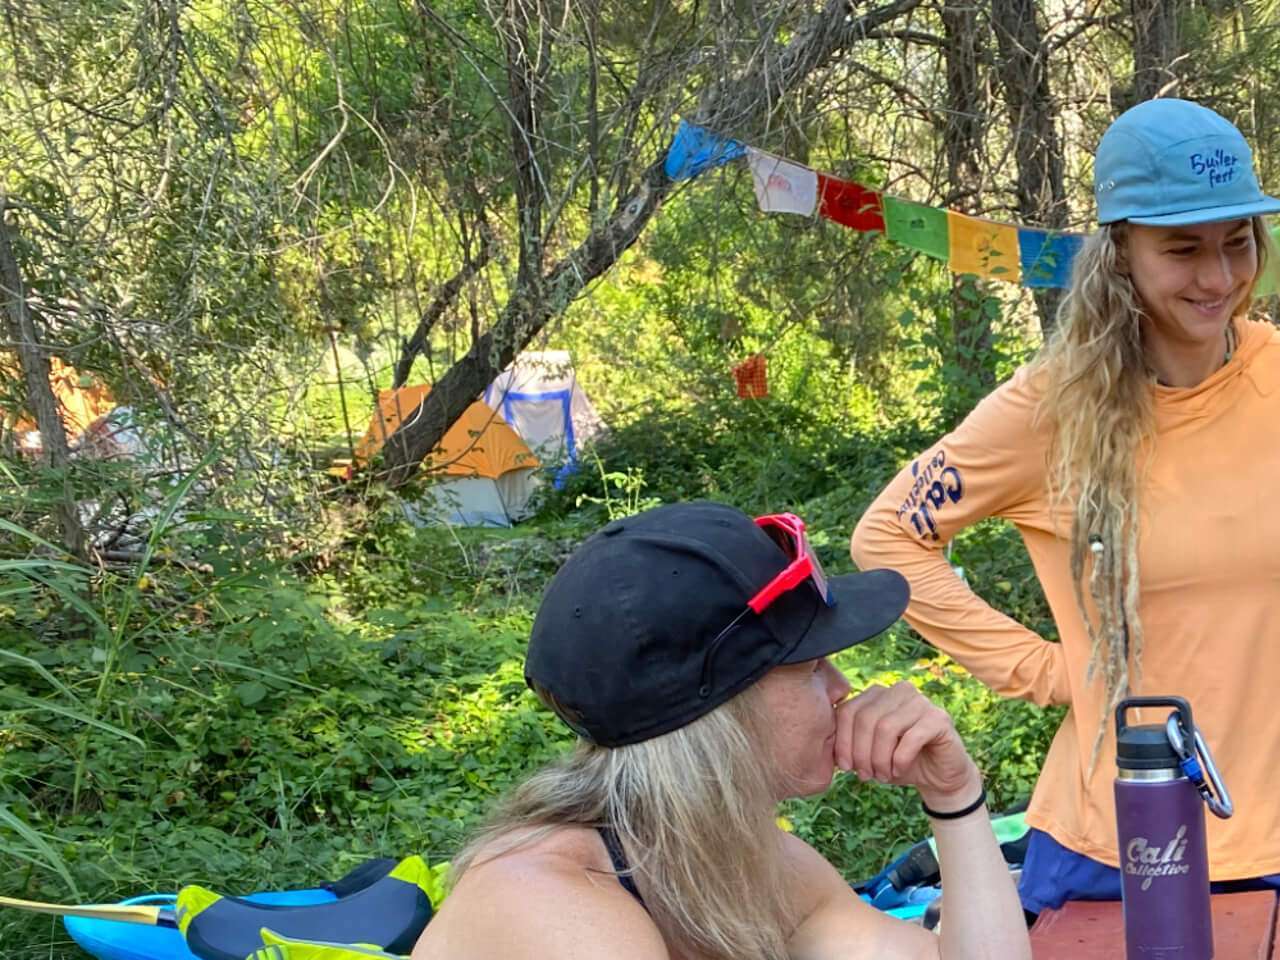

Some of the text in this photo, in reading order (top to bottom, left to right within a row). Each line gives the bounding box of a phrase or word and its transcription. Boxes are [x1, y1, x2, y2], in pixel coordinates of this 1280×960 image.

[910, 466, 963, 541] Cali
[1127, 825, 1188, 866] Cali
[1125, 862, 1190, 878] Collective
